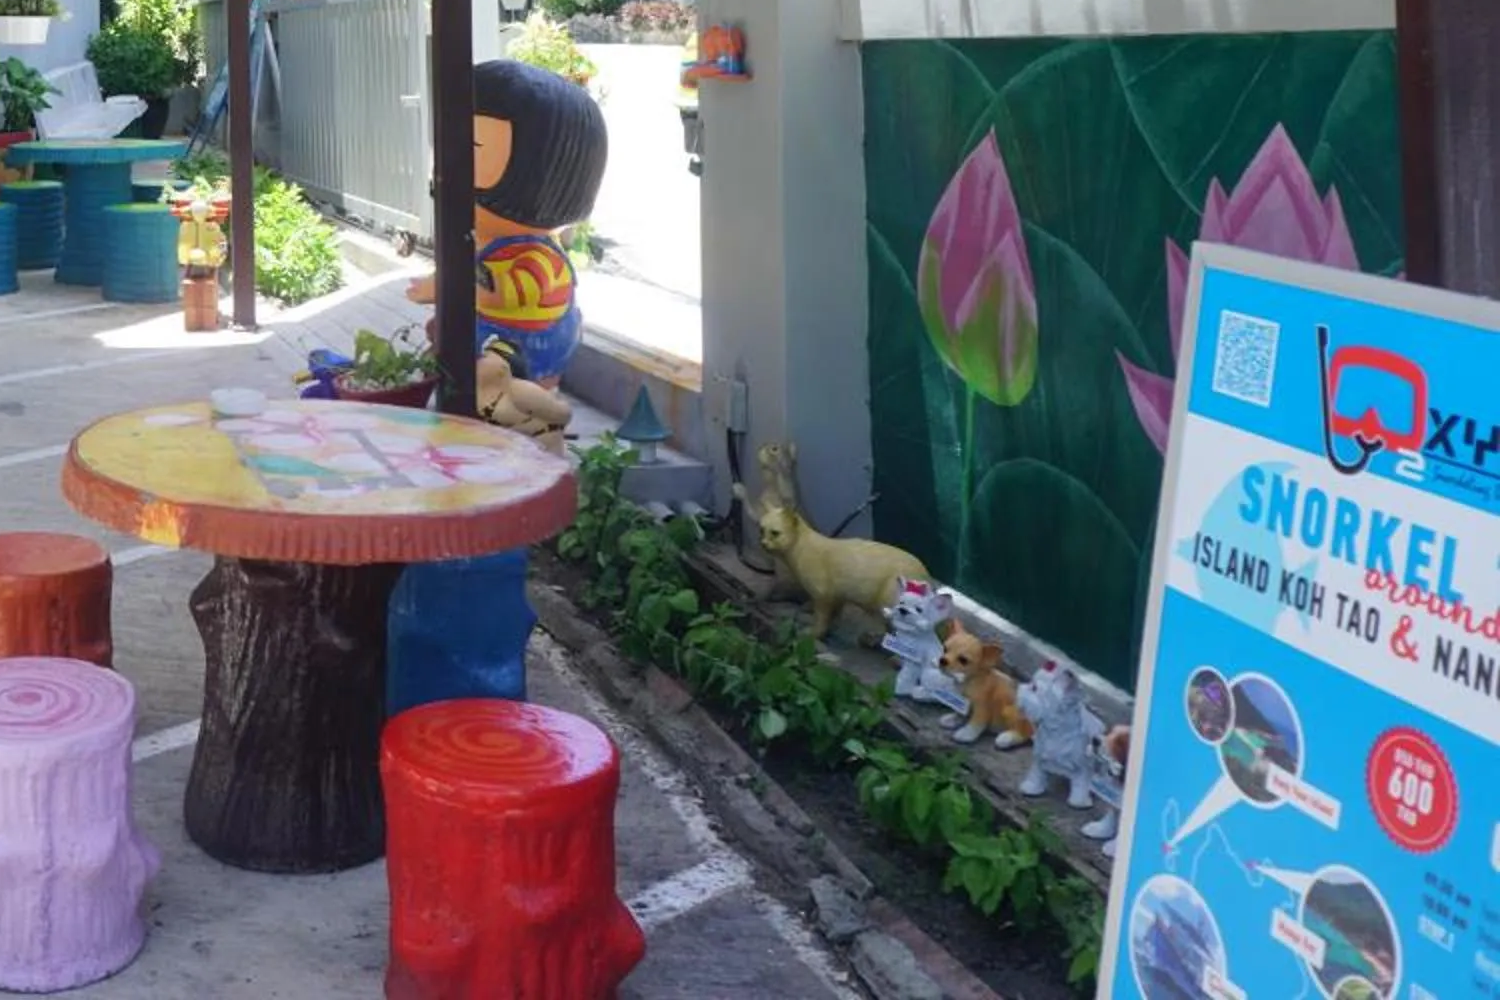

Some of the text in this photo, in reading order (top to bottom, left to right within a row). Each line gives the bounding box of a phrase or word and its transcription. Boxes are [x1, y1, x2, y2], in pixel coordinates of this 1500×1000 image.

[1239, 464, 1463, 603] SNORKEL
[1193, 531, 1500, 701] ISLAND KOH TAO & NAN
[1364, 567, 1500, 643] around
[1387, 766, 1435, 816] 600
